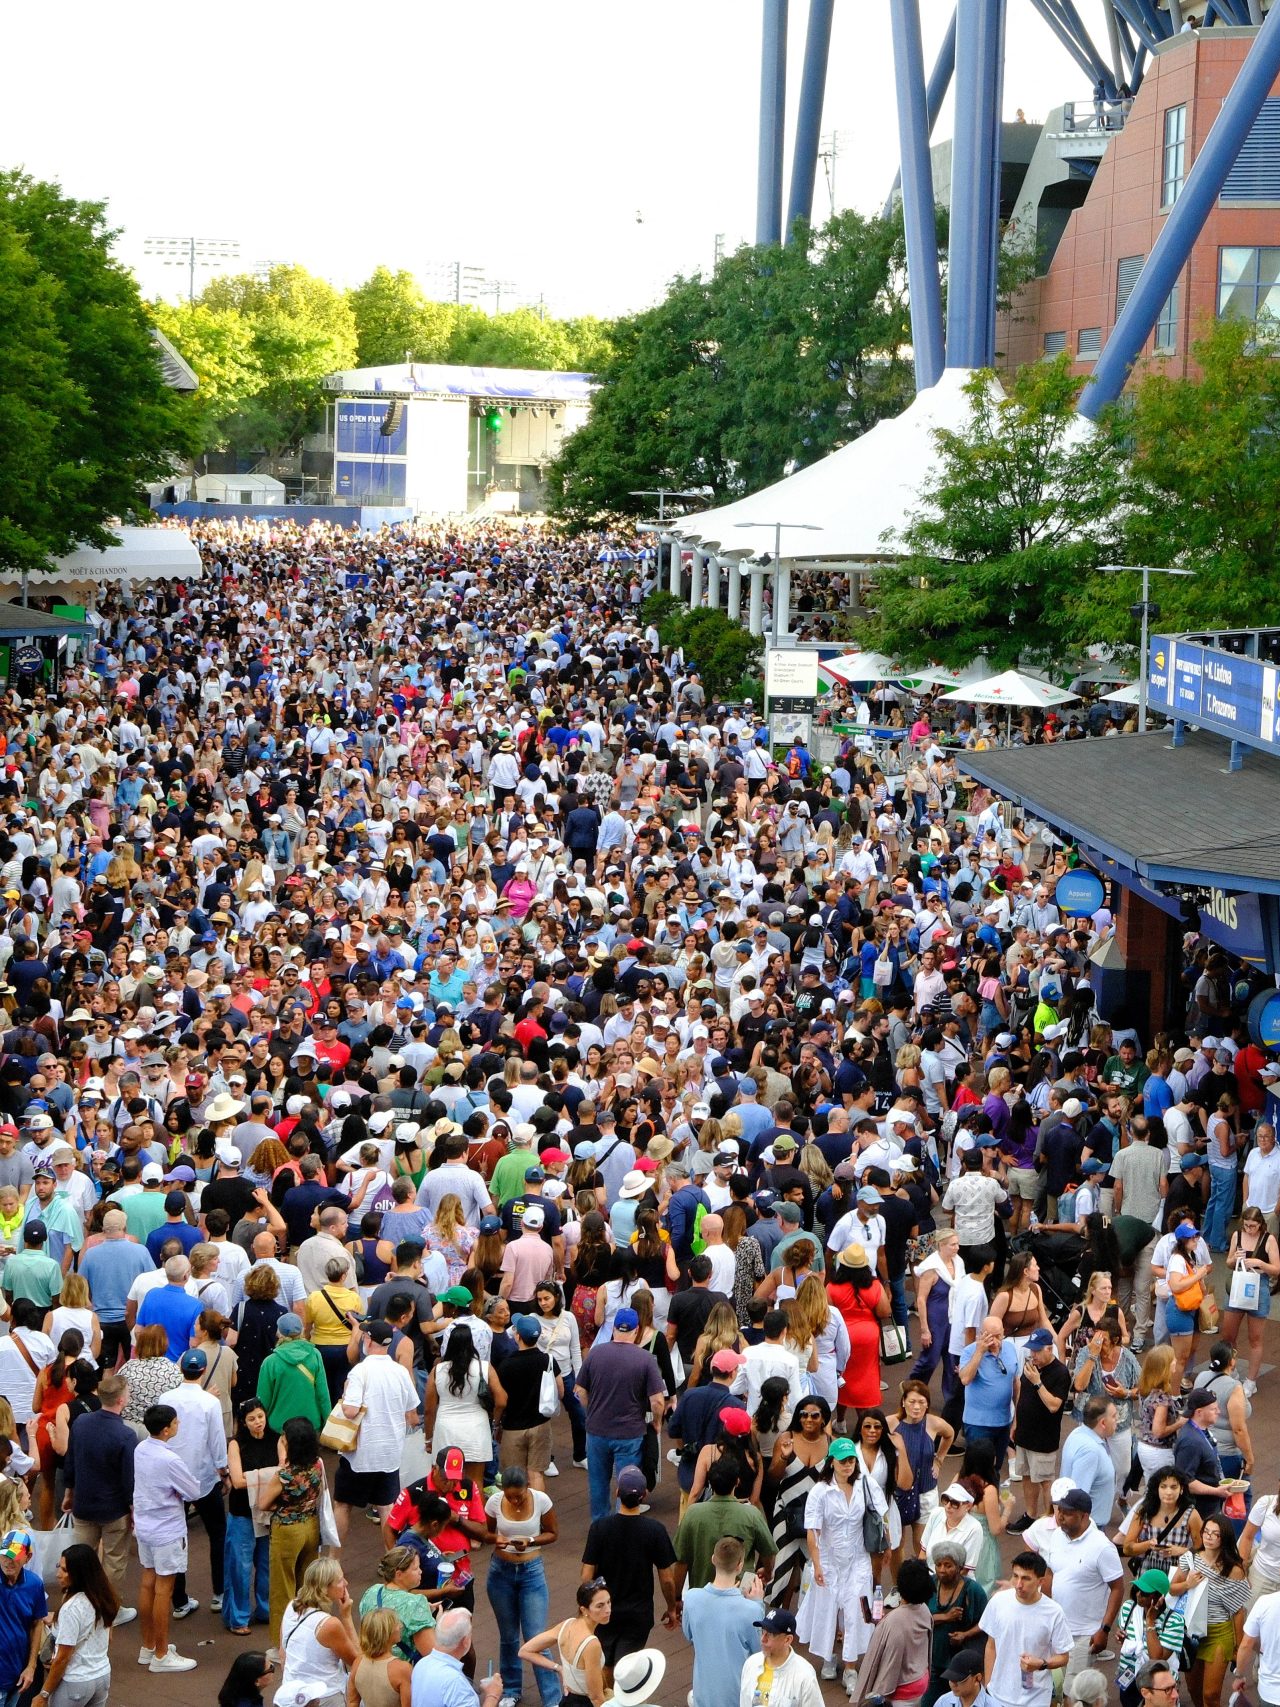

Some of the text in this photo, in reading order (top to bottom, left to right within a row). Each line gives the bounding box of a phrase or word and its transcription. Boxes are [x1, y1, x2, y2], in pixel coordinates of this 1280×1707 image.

[339, 414, 348, 422] US
[95, 567, 128, 575] CHANDON
[1275, 717, 1280, 736] 4
[1068, 890, 1092, 898] Apparel
[875, 1097, 890, 1110] 14
[375, 1200, 396, 1210] ally
